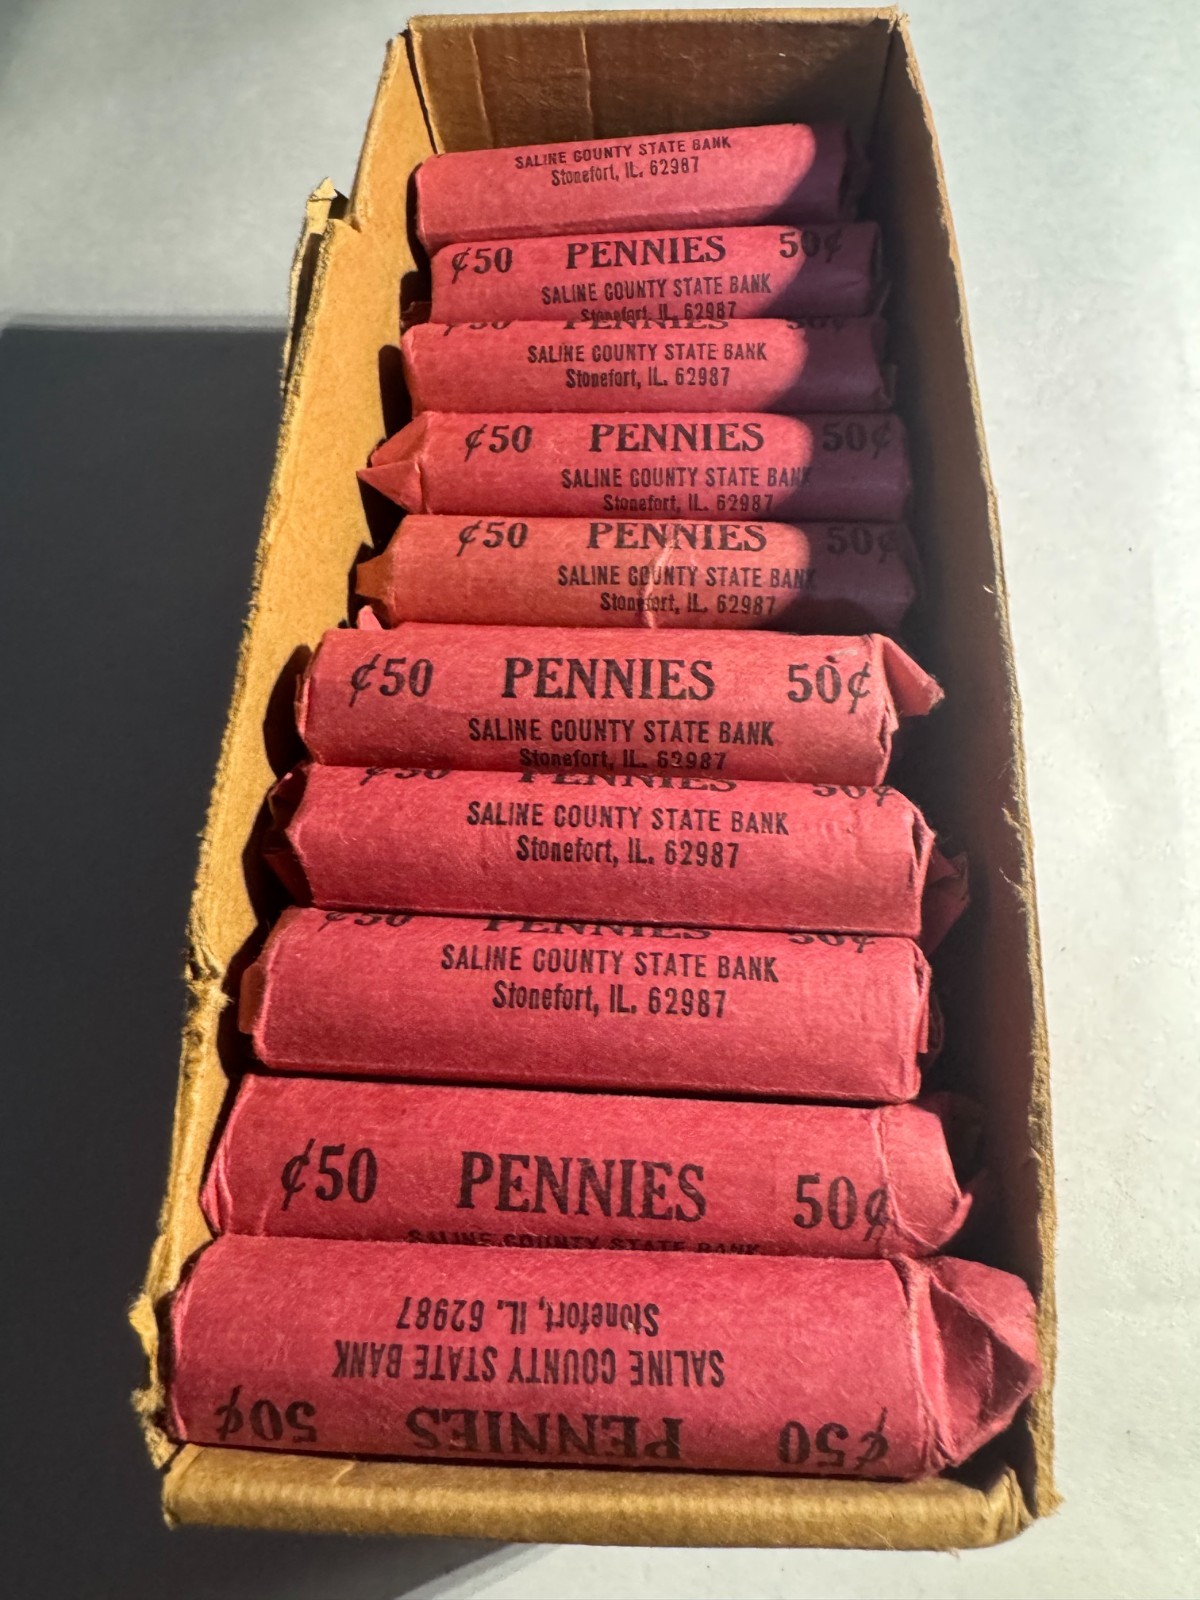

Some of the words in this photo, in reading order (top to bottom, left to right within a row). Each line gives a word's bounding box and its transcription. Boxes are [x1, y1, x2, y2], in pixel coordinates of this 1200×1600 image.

[515, 149, 567, 170] SALINE
[574, 144, 632, 163] COUNTY
[639, 140, 687, 156] STATE
[693, 136, 731, 152] BANK
[551, 164, 619, 186] Stonefort,
[625, 162, 644, 179] IL.
[649, 156, 699, 176] 62987
[452, 246, 513, 285] ¢50
[567, 235, 726, 269] PENNIES
[779, 229, 843, 261] 50¢
[541, 285, 599, 305] SALINE
[605, 279, 666, 300] COUNTY
[674, 277, 724, 296] STATE
[729, 273, 772, 293] BANK
[581, 306, 653, 322] Stonefort
[684, 301, 736, 320] 62987
[528, 344, 584, 363] SALINE
[591, 343, 656, 361] COUNTY
[664, 343, 715, 361] STATE
[724, 343, 767, 361] BANK
[566, 369, 641, 389] Stonefort,
[647, 368, 668, 386] IL.
[675, 367, 729, 387] 62987
[465, 424, 532, 462] ¢50
[589, 423, 764, 452] PENNIES
[561, 469, 622, 488] SALINE
[629, 468, 697, 487] COUNTY
[705, 467, 759, 486] STATE
[768, 467, 812, 487] BANK
[603, 494, 681, 514] Stonefort,
[686, 494, 710, 511] IL.
[716, 493, 773, 512] 62987
[457, 520, 528, 557] ¢50
[586, 522, 767, 552] PENNIES
[558, 566, 620, 586] SALINE
[628, 566, 698, 586] COUNTY
[705, 568, 761, 587] STATE
[770, 567, 815, 589] BANK
[687, 593, 709, 613] IL.
[716, 594, 775, 615] 62987
[350, 653, 434, 708] ¢50
[502, 658, 715, 700] PENNIES
[787, 658, 872, 714] 50¢
[469, 718, 541, 742] SALINE
[550, 719, 635, 743] COUNTY
[643, 719, 710, 744] STATE
[719, 721, 775, 747] BANK
[520, 746, 618, 771] Stonefort,
[623, 747, 649, 768] IL.
[656, 748, 726, 771] 62987
[467, 802, 542, 827] SALINE
[554, 805, 644, 830] COUNTY
[651, 808, 722, 832] STATE
[731, 810, 789, 836] BANK
[516, 836, 619, 867] Stonefort,
[627, 840, 655, 865] IL.
[665, 840, 740, 868] 62987
[441, 944, 522, 972] SALINE
[533, 947, 626, 976] COUNTY
[633, 952, 707, 978] STATE
[717, 956, 779, 983] BANK
[492, 980, 600, 1017] Stonefort,
[608, 986, 638, 1014] IL.
[648, 987, 727, 1018] 62987
[280, 1139, 378, 1211] ¢50
[457, 1151, 708, 1223] PENNIES
[396, 1296, 483, 1330] 62987
[497, 1300, 525, 1333] IL.
[539, 1298, 661, 1335] Stonefort,
[333, 1339, 402, 1379] BANK
[413, 1344, 498, 1382] STATE
[507, 1346, 615, 1387] COUNTY
[631, 1350, 725, 1388] SALINE
[214, 1384, 318, 1443] 50¢
[405, 1406, 685, 1460] PENNIES
[777, 1406, 890, 1470] ¢50
